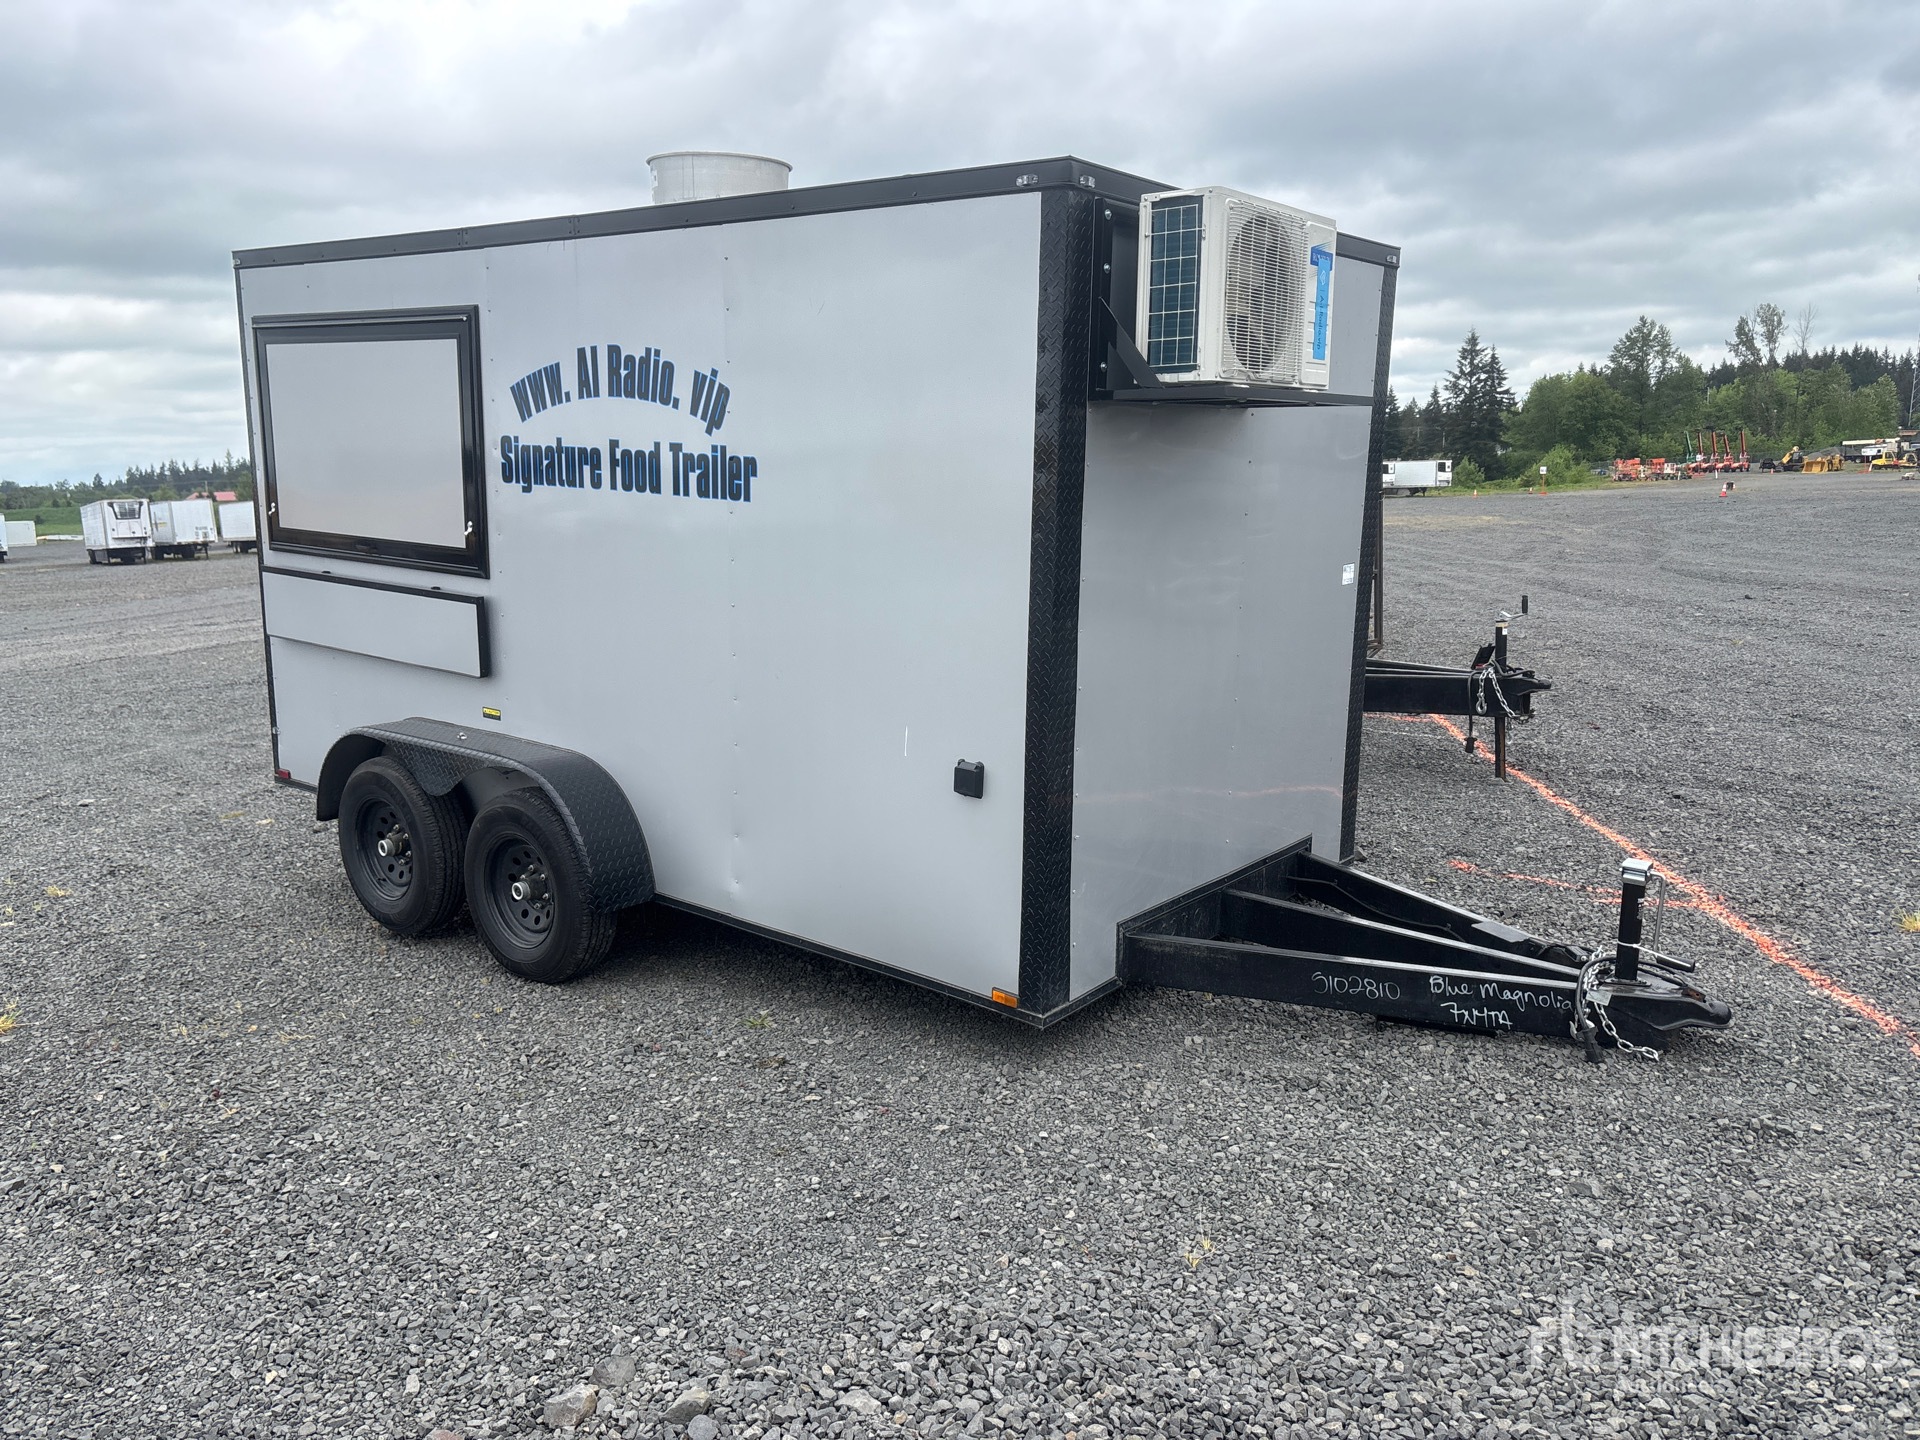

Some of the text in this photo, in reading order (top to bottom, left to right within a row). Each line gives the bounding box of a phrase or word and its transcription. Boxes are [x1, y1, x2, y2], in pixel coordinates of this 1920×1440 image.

[606, 343, 680, 411] Radio.
[689, 367, 730, 437] vip
[500, 435, 758, 502] Signature Food Trailer
[1429, 975, 1473, 996] Blue
[1480, 982, 1574, 1012] Magnolia
